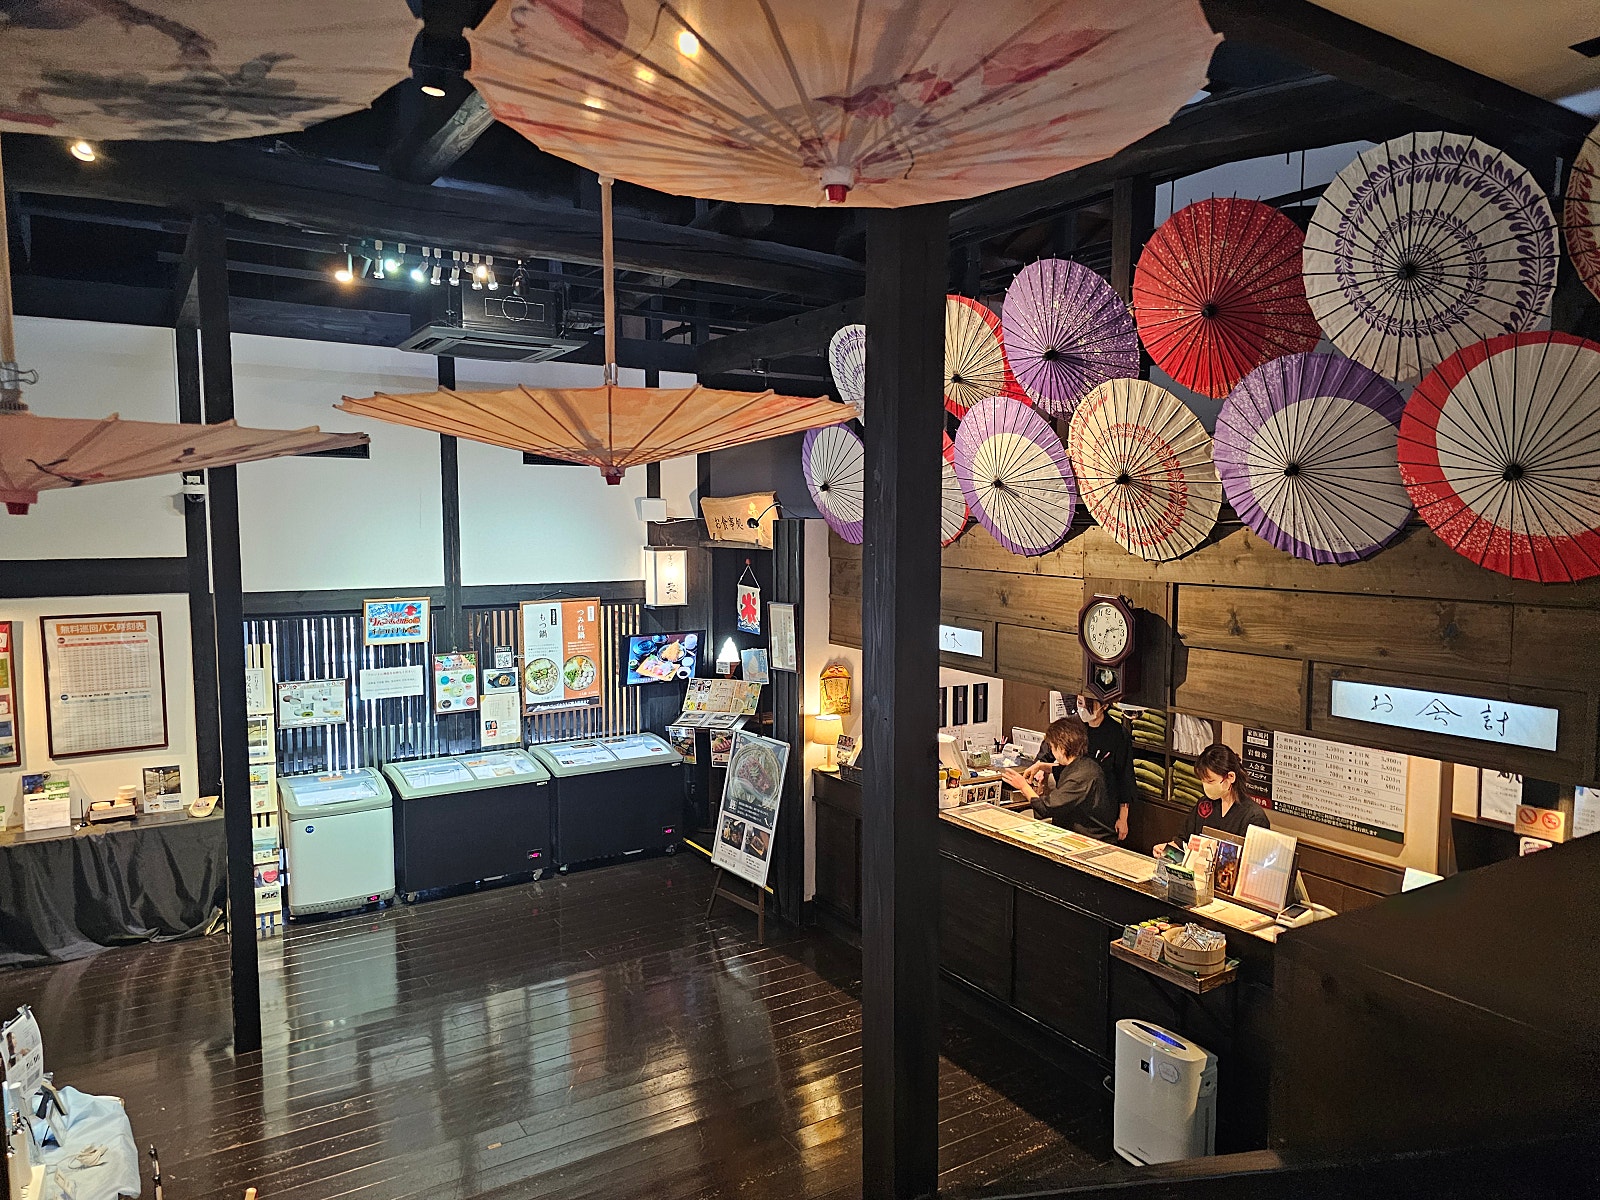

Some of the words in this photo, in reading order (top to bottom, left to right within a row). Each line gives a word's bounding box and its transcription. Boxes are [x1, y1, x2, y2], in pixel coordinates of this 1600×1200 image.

[714, 515, 744, 531] お食事処
[60, 621, 146, 635] 無料巡回バス時刻表
[538, 613, 548, 639] もつ鍋
[576, 609, 586, 640] つみれ鍋
[1370, 693, 1510, 737] お会計
[1247, 748, 1267, 759] 岩盤浴
[1248, 761, 1265, 771] 入会金
